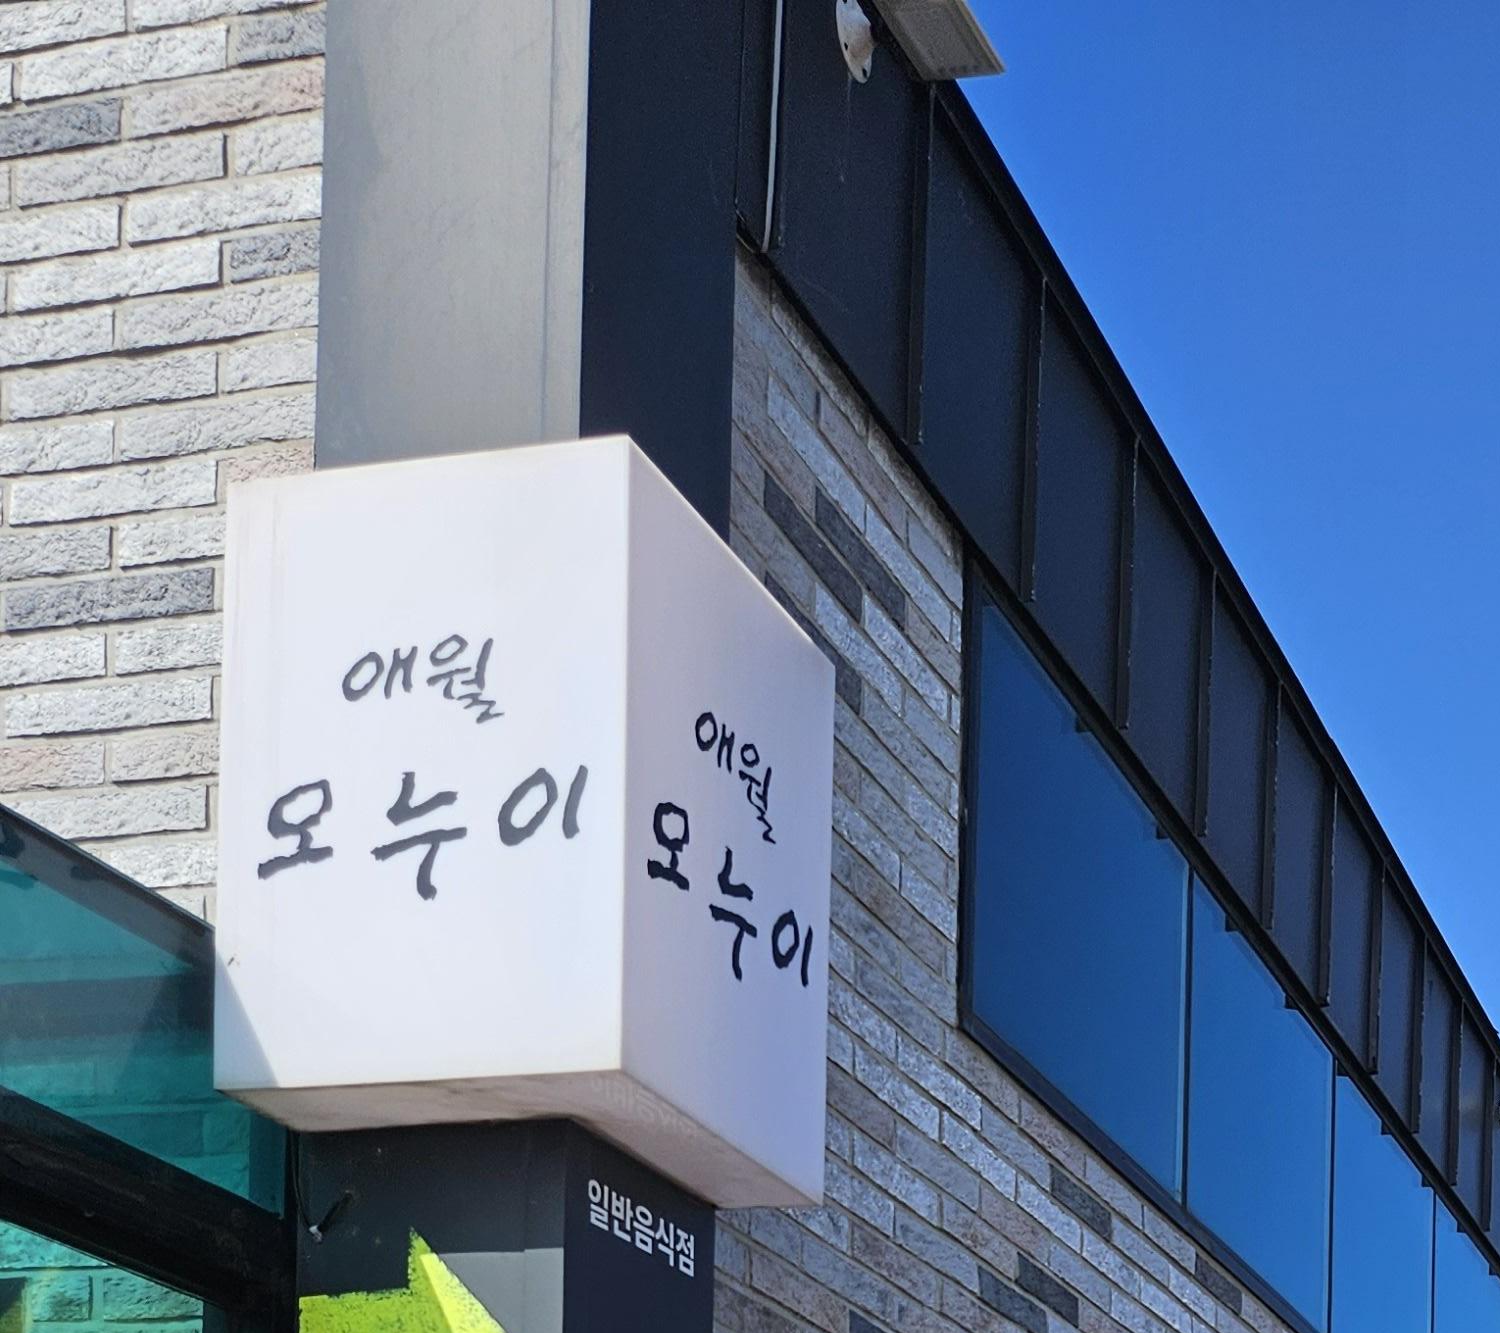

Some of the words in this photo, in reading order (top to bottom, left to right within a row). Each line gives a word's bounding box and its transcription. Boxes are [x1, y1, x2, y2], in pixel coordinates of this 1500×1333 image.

[342, 633, 505, 725] 애월
[257, 763, 589, 901] 오누이
[694, 711, 776, 844] 애월
[646, 801, 814, 989] 오누이
[588, 1179, 696, 1279] 일반음식점
